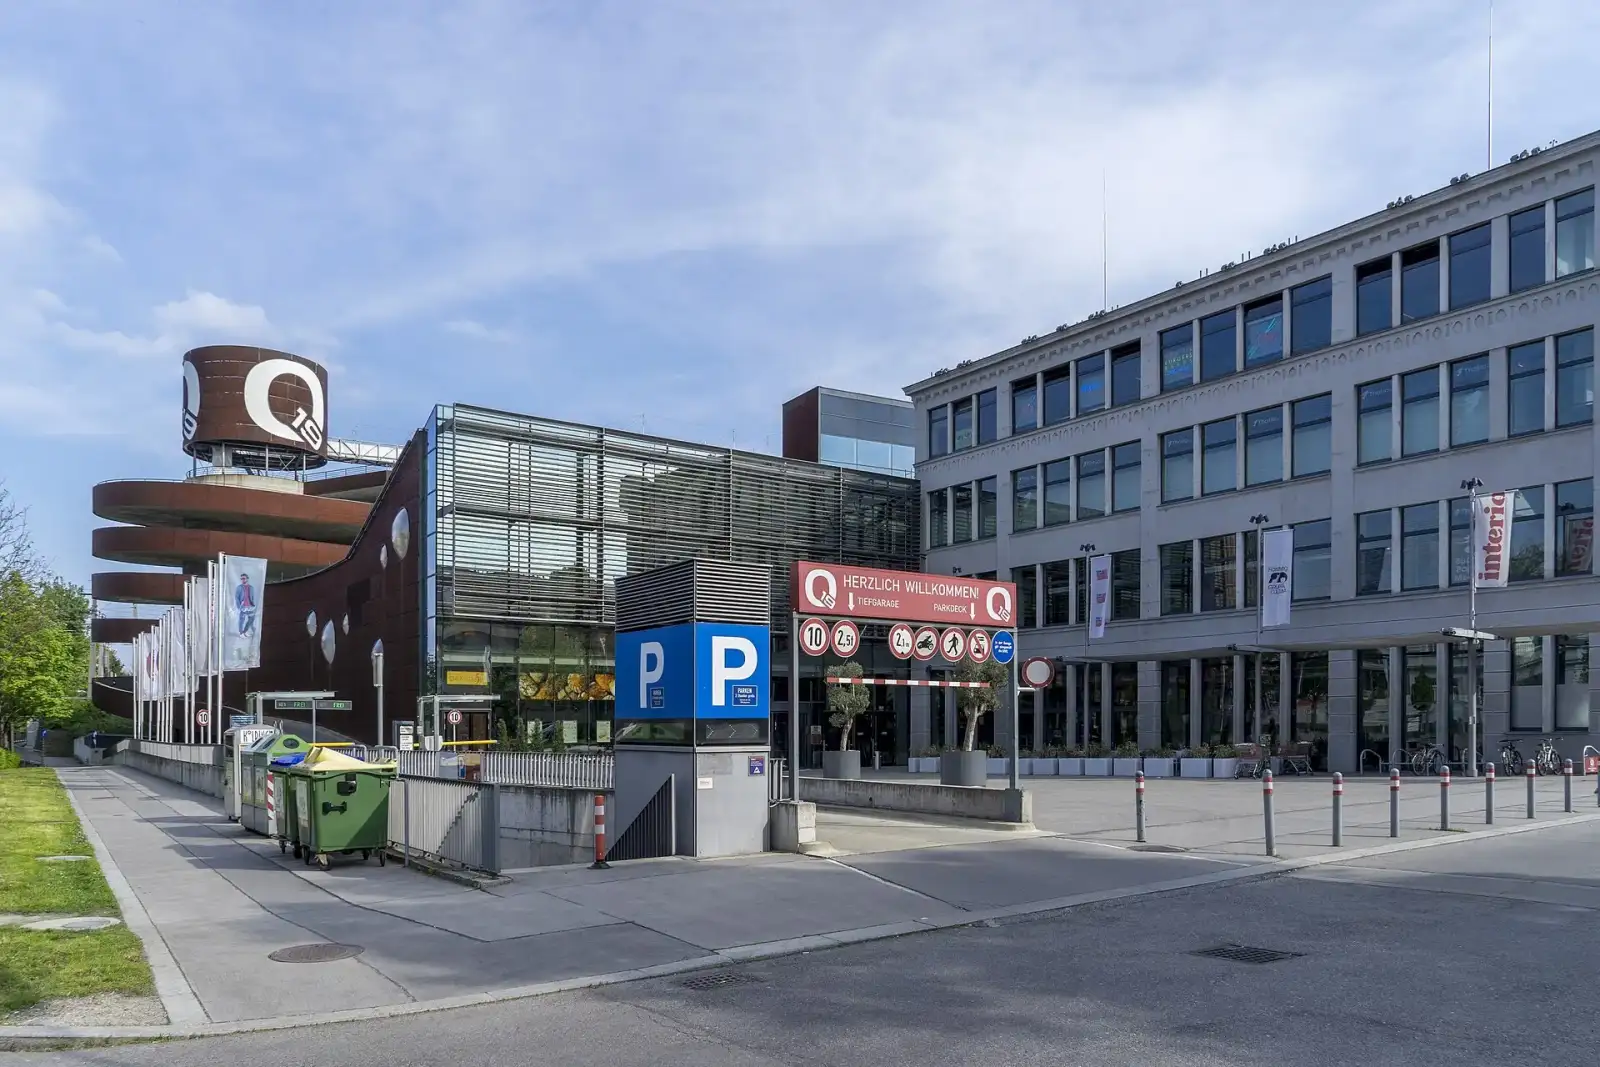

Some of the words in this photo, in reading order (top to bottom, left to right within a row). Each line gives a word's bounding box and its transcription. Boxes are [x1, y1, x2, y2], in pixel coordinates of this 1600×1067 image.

[1478, 492, 1505, 580] interio
[843, 574, 900, 592] HERZLICH
[904, 580, 979, 599] WILLKOMMEN!
[857, 597, 900, 608] TIEFGARAGE
[933, 603, 968, 613] PARKDECK
[807, 627, 822, 647] 10
[640, 641, 665, 708] P
[712, 636, 758, 706] P
[200, 714, 208, 723] 10
[451, 713, 459, 721] 10
